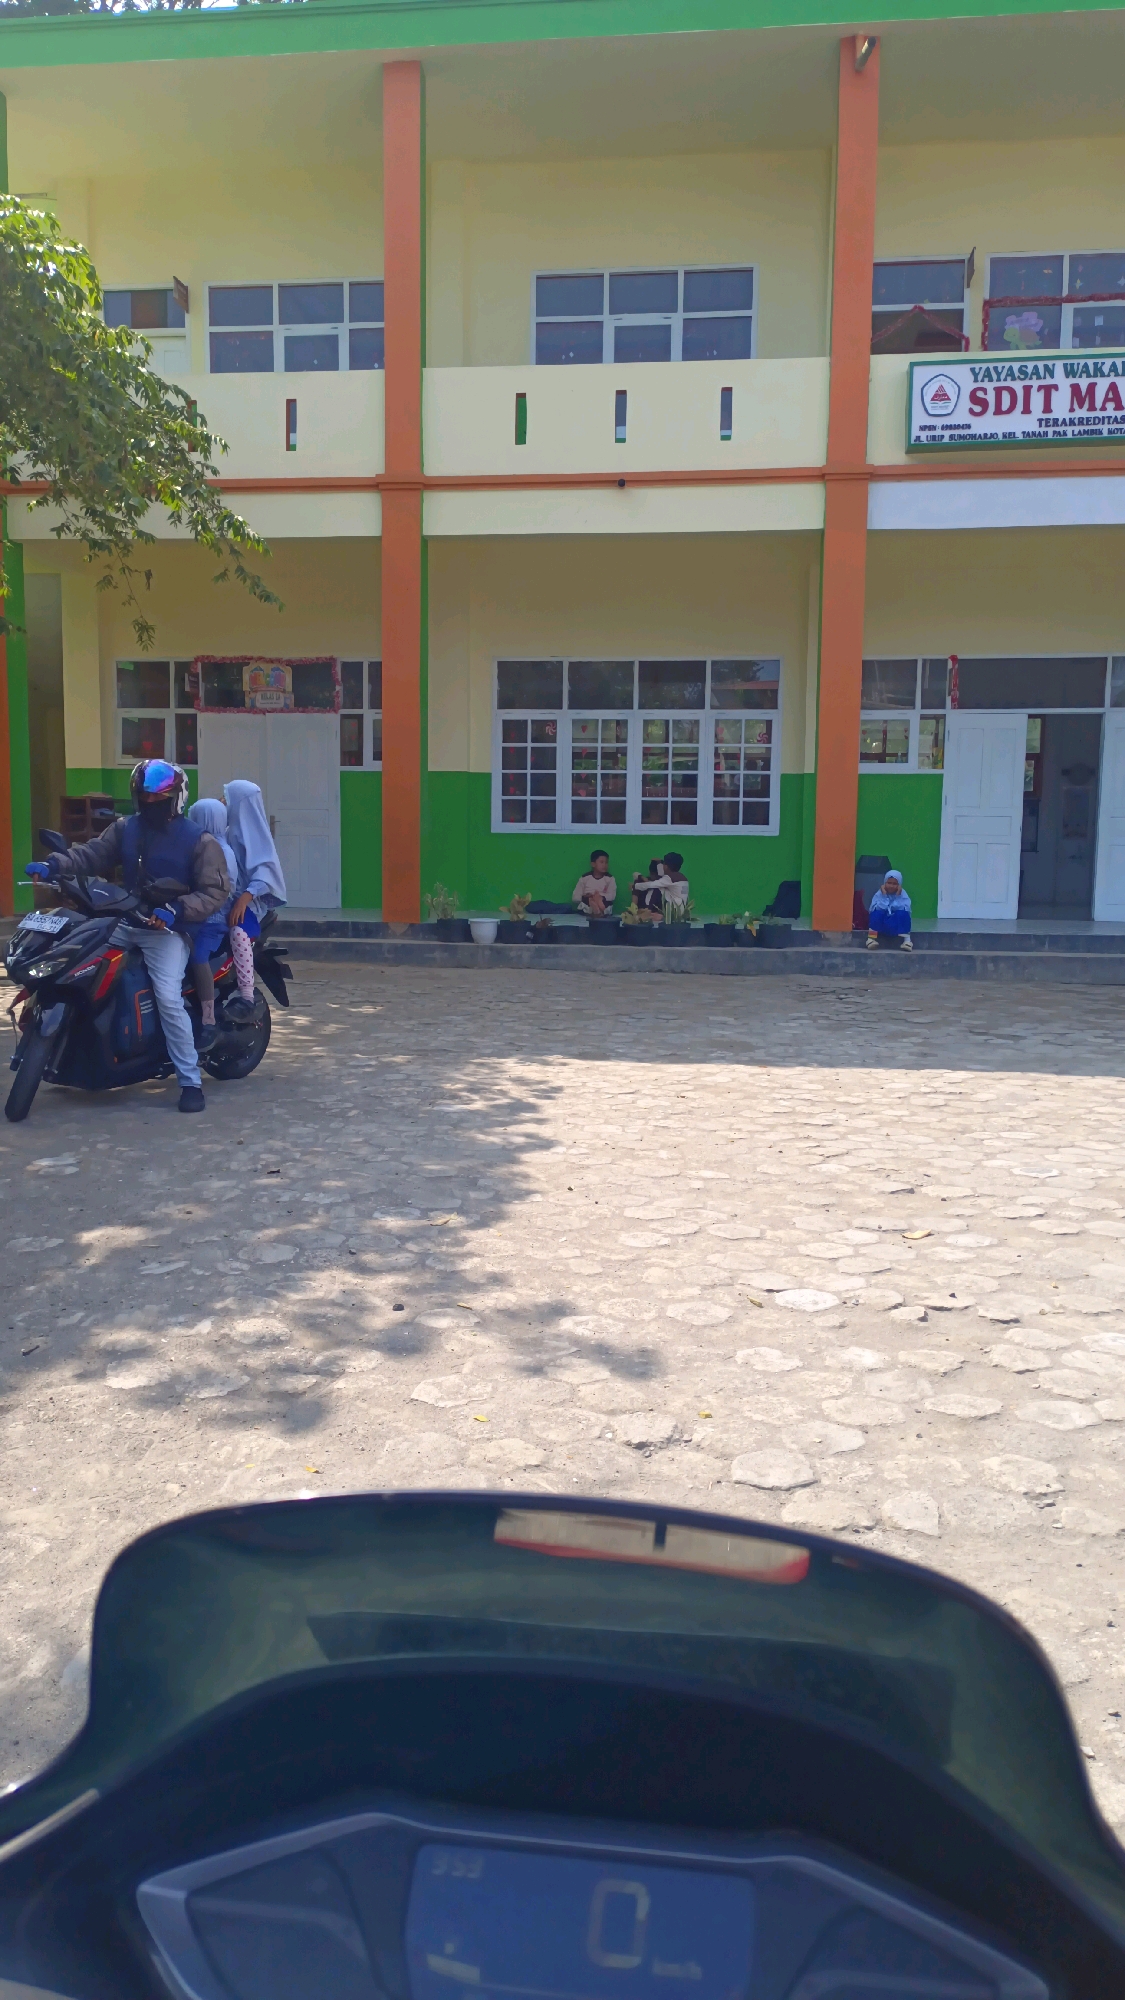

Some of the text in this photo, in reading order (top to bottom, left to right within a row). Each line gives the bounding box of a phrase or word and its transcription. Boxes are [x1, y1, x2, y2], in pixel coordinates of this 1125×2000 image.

[970, 363, 1056, 383] YAYASAN
[968, 384, 1059, 417] SDIT
[1068, 381, 1125, 413] MA
[926, 434, 945, 443] URIP
[1021, 430, 1049, 439] TANAH
[1052, 429, 1068, 438] PAK
[1071, 428, 1104, 437] LAMBIK
[74, 964, 96, 977] HONDA
[588, 1879, 650, 1969] 0
